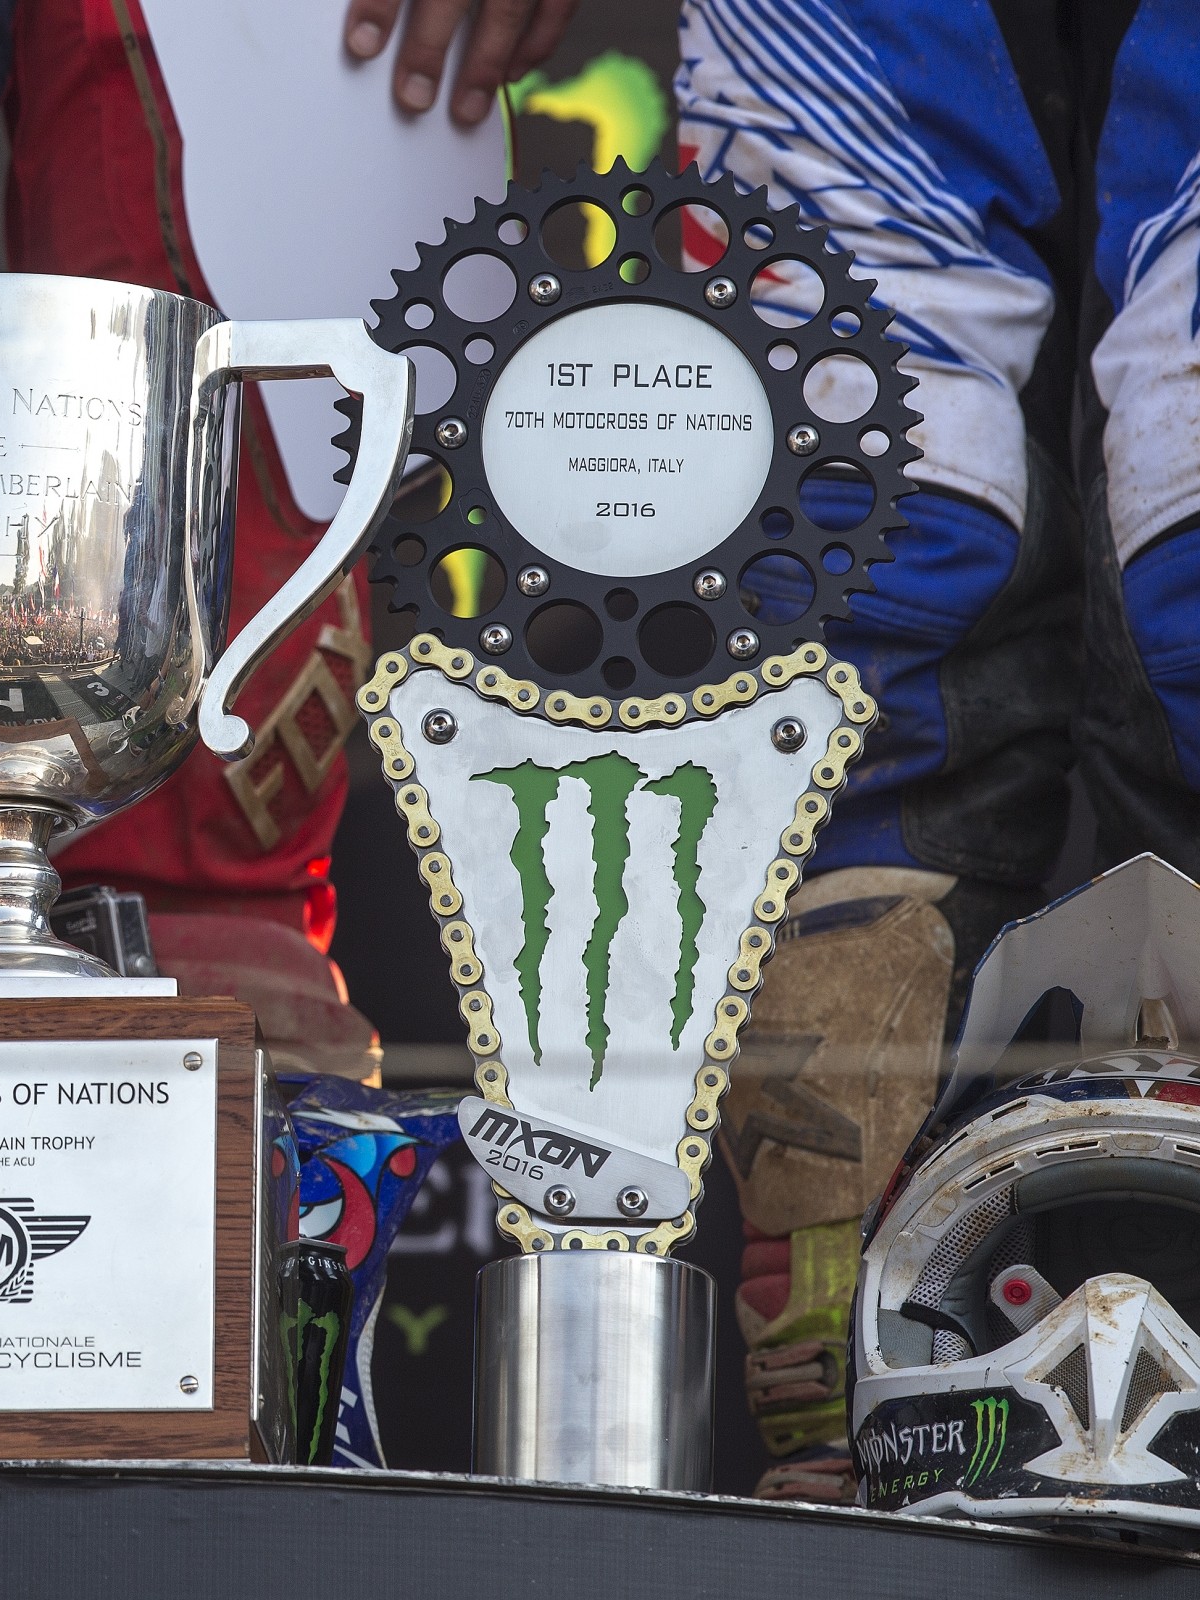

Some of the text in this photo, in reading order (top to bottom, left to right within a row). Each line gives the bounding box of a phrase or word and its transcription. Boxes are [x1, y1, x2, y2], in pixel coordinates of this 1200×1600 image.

[547, 362, 713, 389] 1ST PLACE
[12, 387, 144, 427] NATIONS
[505, 411, 752, 431] 70TH MOTOCROSS OF NATIONS
[568, 457, 685, 475] MAGGIORA, ITALY
[595, 502, 656, 518] 2016
[223, 571, 373, 850] FOX
[12, 1082, 49, 1106] OF
[58, 1081, 169, 1105] NATIONS
[31, 1136, 96, 1150] TROPHY
[468, 1107, 612, 1179] MXON
[13, 1156, 36, 1167] ACU
[485, 1149, 544, 1181] 2016
[856, 1419, 967, 1475] MONSTER
[870, 1468, 944, 1503] ENERGY
